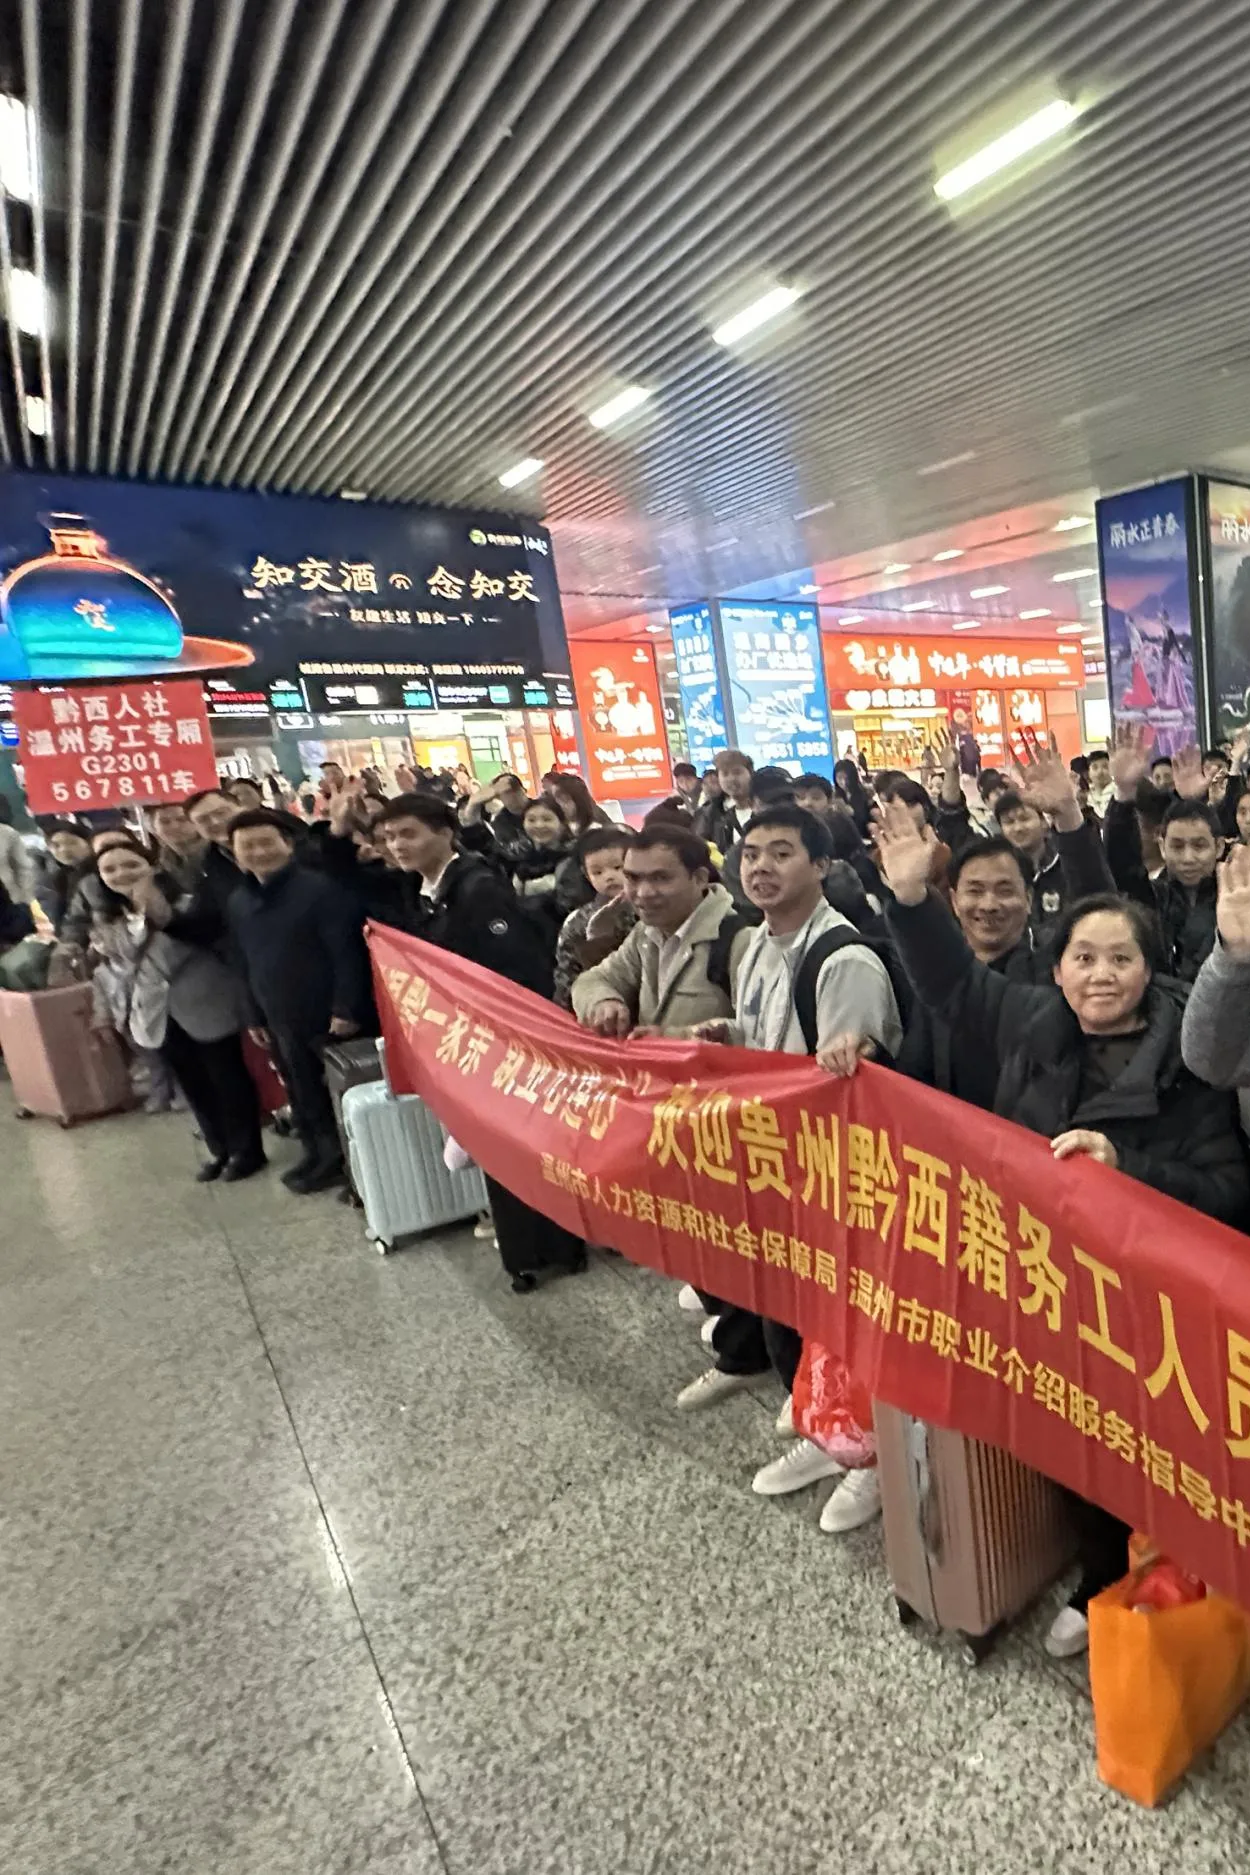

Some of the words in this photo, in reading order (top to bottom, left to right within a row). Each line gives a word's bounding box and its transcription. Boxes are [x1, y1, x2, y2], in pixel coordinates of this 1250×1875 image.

[1109, 511, 1181, 549] 丽水正青春
[251, 556, 378, 594] 知交酒
[427, 565, 540, 602] 念知交
[50, 690, 171, 725] 黔西人社
[26, 717, 203, 757] 温州务工专厢
[81, 752, 161, 775] G2301
[540, 1151, 838, 1294] 温州市人力资源和社会保障局
